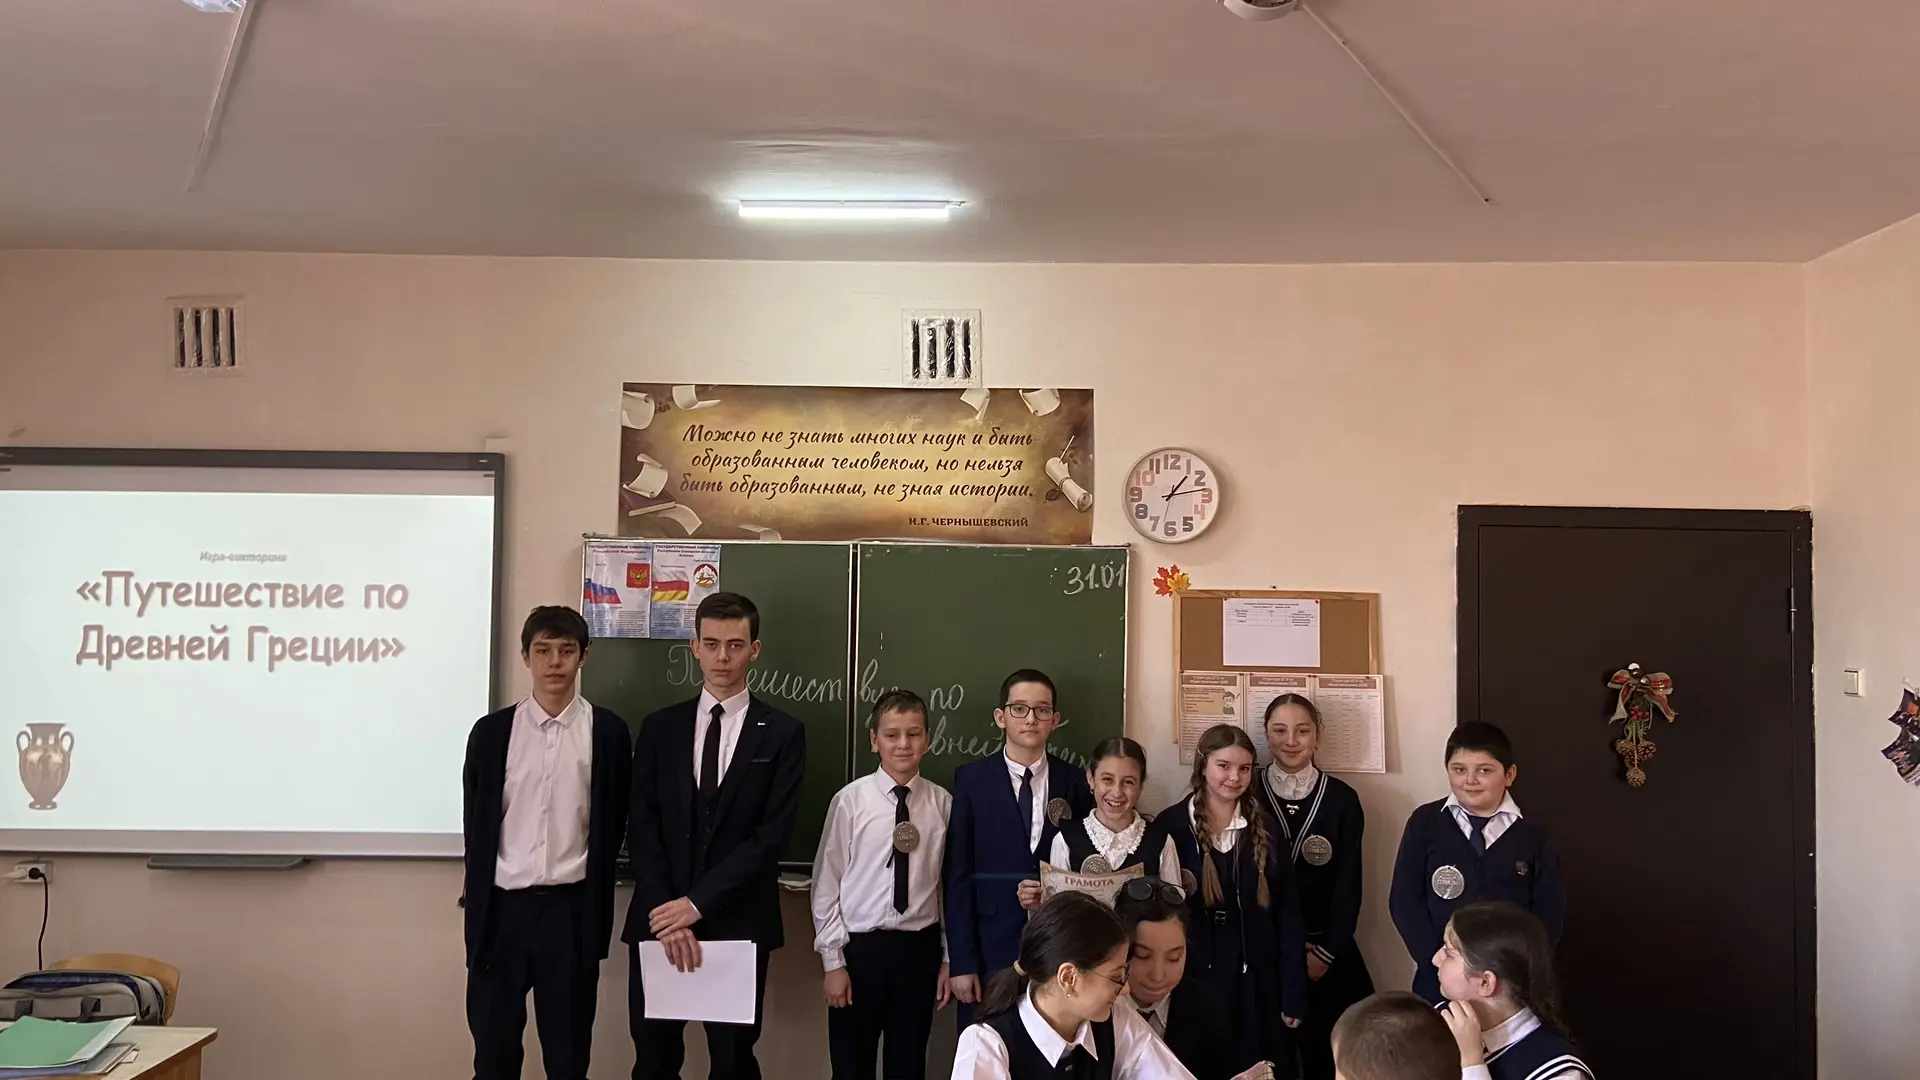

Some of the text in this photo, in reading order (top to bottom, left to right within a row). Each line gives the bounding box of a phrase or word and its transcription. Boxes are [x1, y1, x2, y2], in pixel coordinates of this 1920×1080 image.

[682, 424, 1033, 451] Можно не знать многих наук и быть
[691, 448, 1024, 477] образованным человеком, но нельзя
[1149, 459, 1160, 474] 11
[1163, 454, 1181, 470] 12
[1186, 459, 1191, 475] 1
[1135, 470, 1155, 486] 10
[1194, 470, 1206, 486] 2
[680, 473, 1033, 503] быть образованным, не зная истории.
[1129, 486, 1142, 502] 9
[1201, 488, 1213, 504] 3
[1135, 503, 1148, 519] 8
[1194, 504, 1205, 520] 4
[908, 516, 1028, 527] Н.Г. ЧЕРНЫШЕВСКИЙ
[1149, 516, 1160, 532] 7
[1163, 521, 1177, 536] 6
[1182, 516, 1194, 532] 5
[200, 551, 288, 564] Игра-викторина
[1063, 562, 1125, 595] 31.01
[76, 570, 409, 618] «Путешествие по
[76, 624, 407, 673] Древней Греции»
[930, 683, 964, 712] по
[1064, 876, 1114, 888] ГРАМОТА
